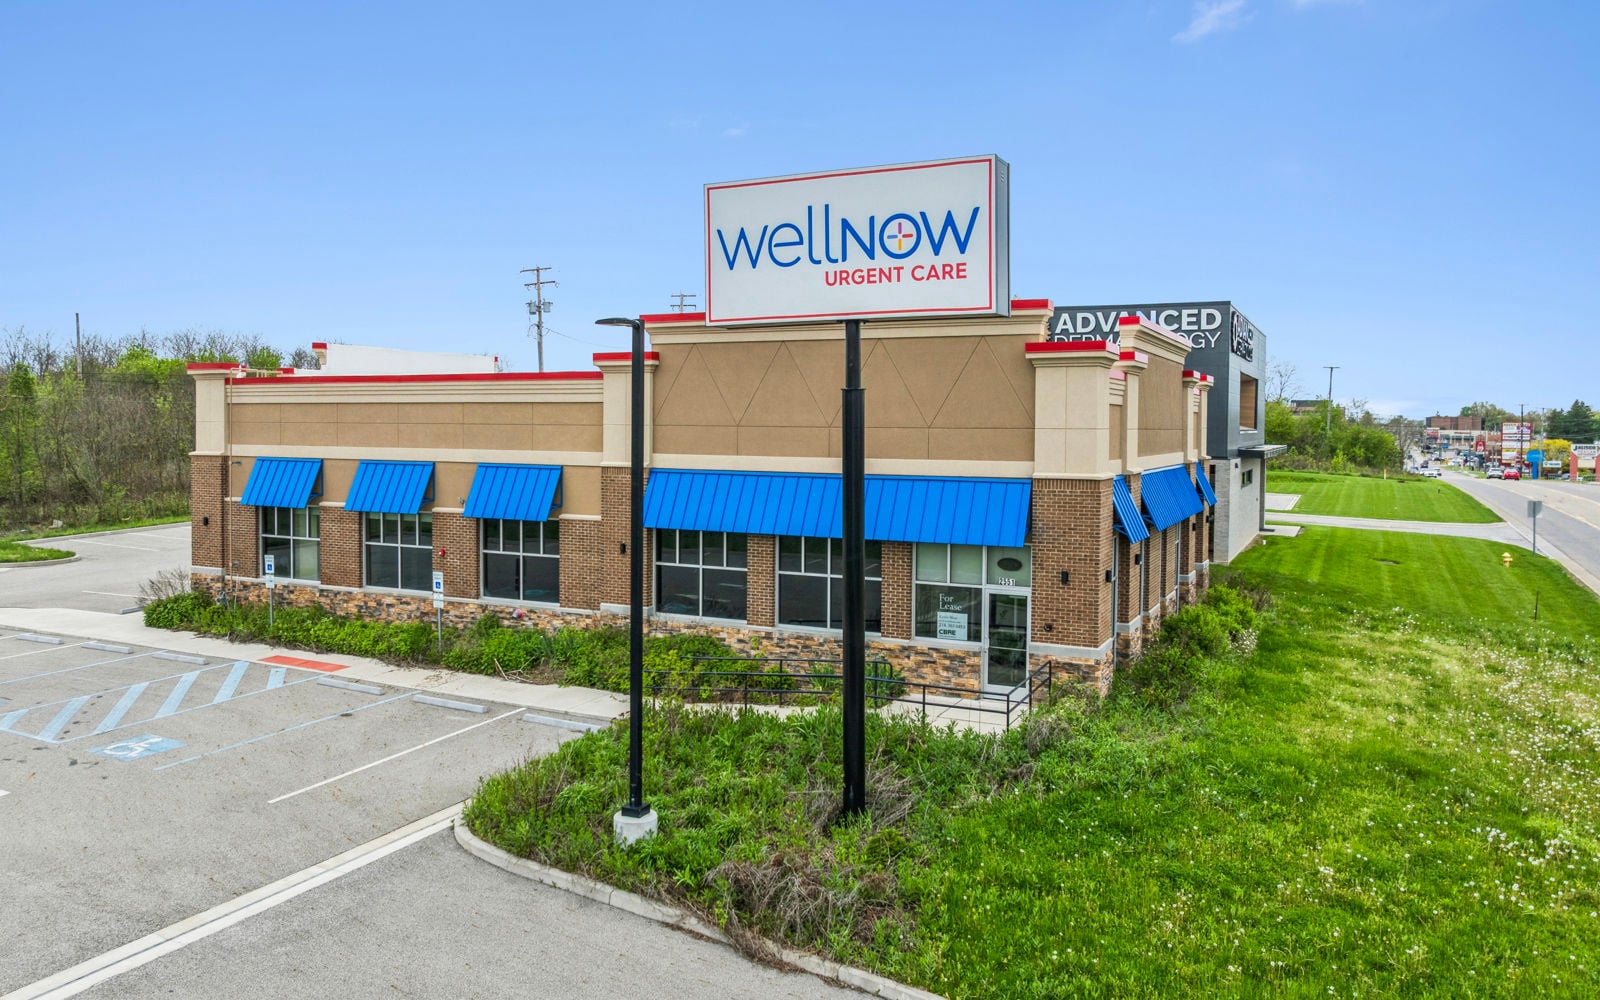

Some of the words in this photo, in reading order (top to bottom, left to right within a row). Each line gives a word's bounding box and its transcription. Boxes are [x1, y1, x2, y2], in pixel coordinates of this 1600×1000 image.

[825, 266, 904, 287] URGENT
[911, 262, 967, 282] CARE
[939, 593, 954, 602] For
[939, 601, 963, 611] Lease
